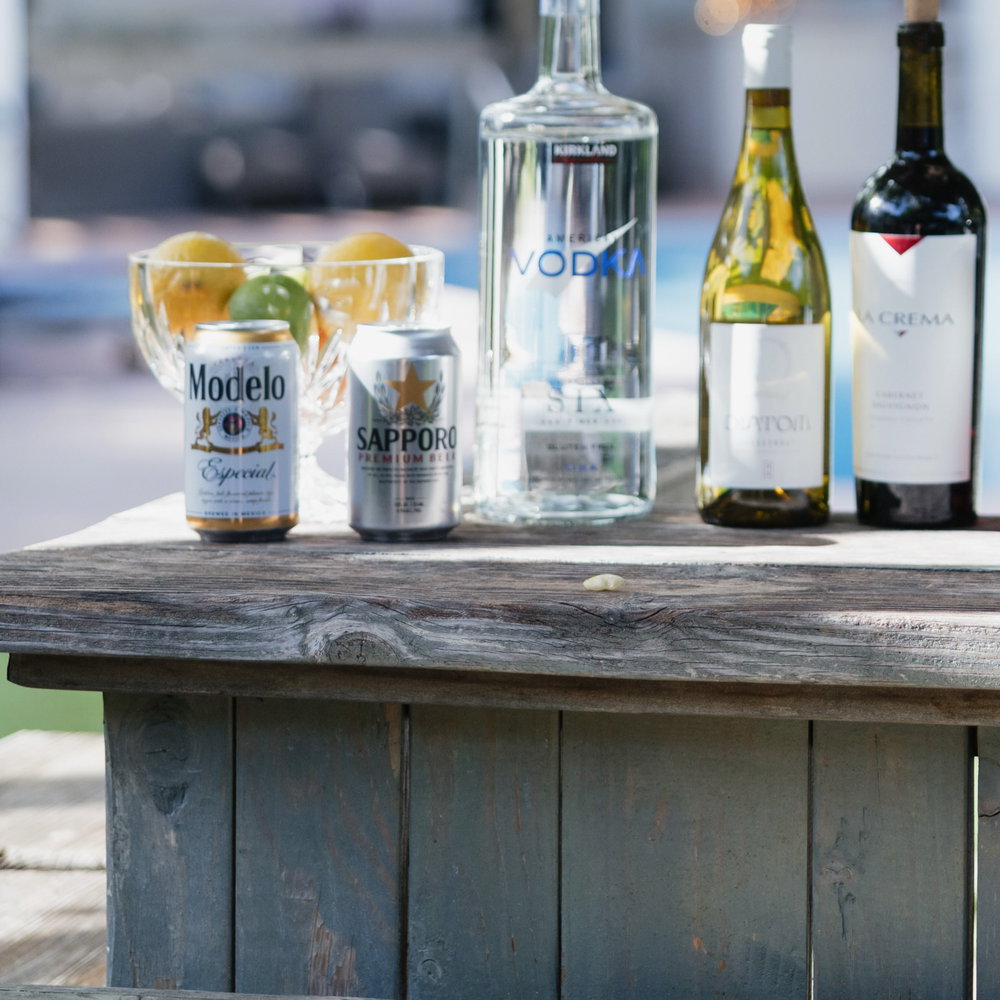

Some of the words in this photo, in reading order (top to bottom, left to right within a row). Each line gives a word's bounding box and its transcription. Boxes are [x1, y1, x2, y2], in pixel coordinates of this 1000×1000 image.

[554, 143, 618, 157] KIRKLAND
[509, 248, 647, 279] VODKA
[878, 310, 954, 326] CREMA
[189, 363, 285, 402] Modelo
[357, 426, 457, 452] SAPPORO
[358, 453, 424, 464] PREMIUM
[199, 457, 275, 487] Especial
